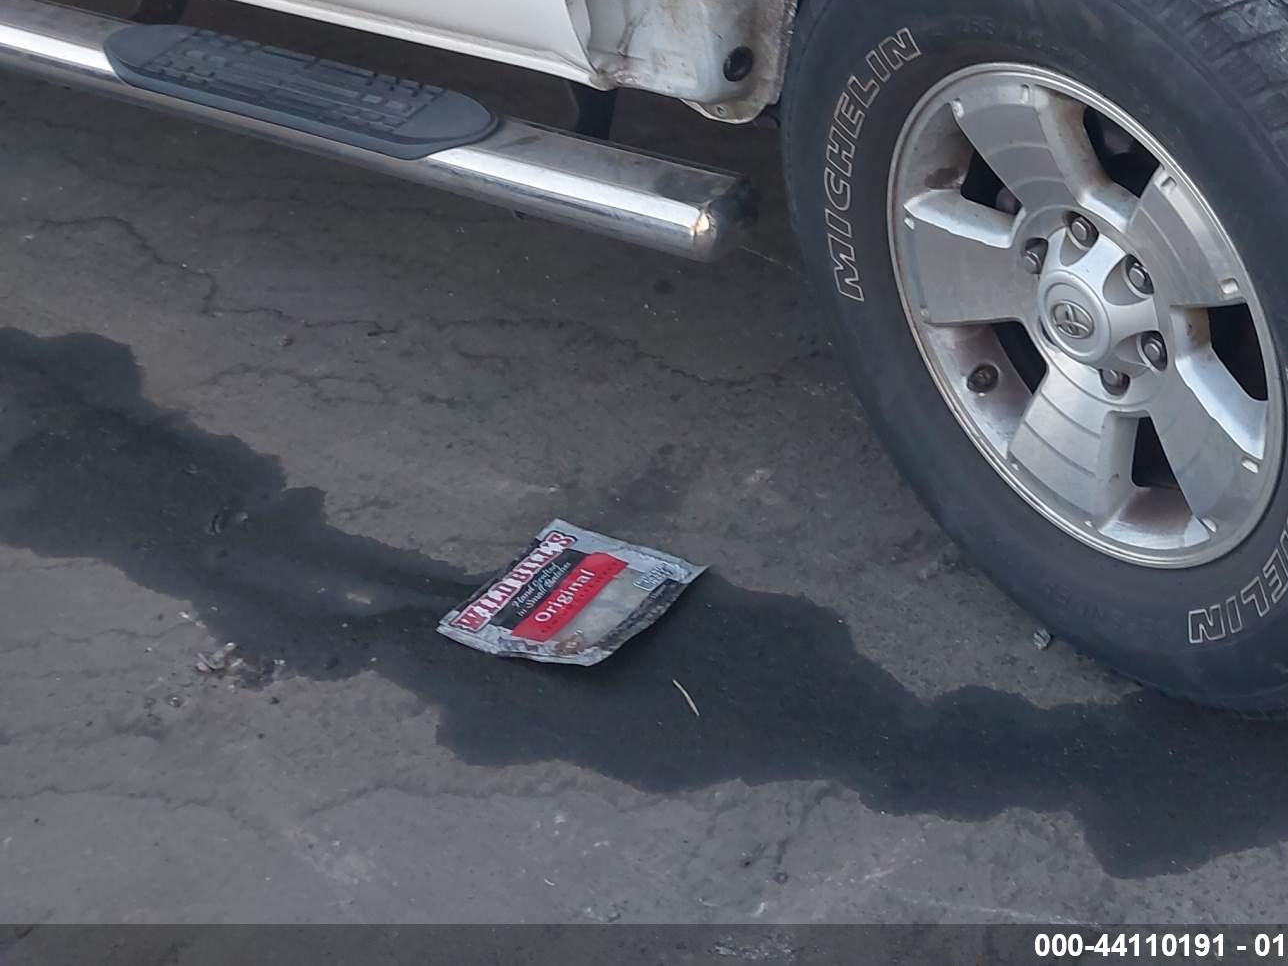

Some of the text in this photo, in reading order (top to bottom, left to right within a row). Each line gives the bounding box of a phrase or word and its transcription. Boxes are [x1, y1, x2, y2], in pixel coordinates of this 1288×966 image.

[824, 27, 922, 301] MICHELIN
[452, 581, 519, 631] WILD
[534, 568, 596, 622] Original
